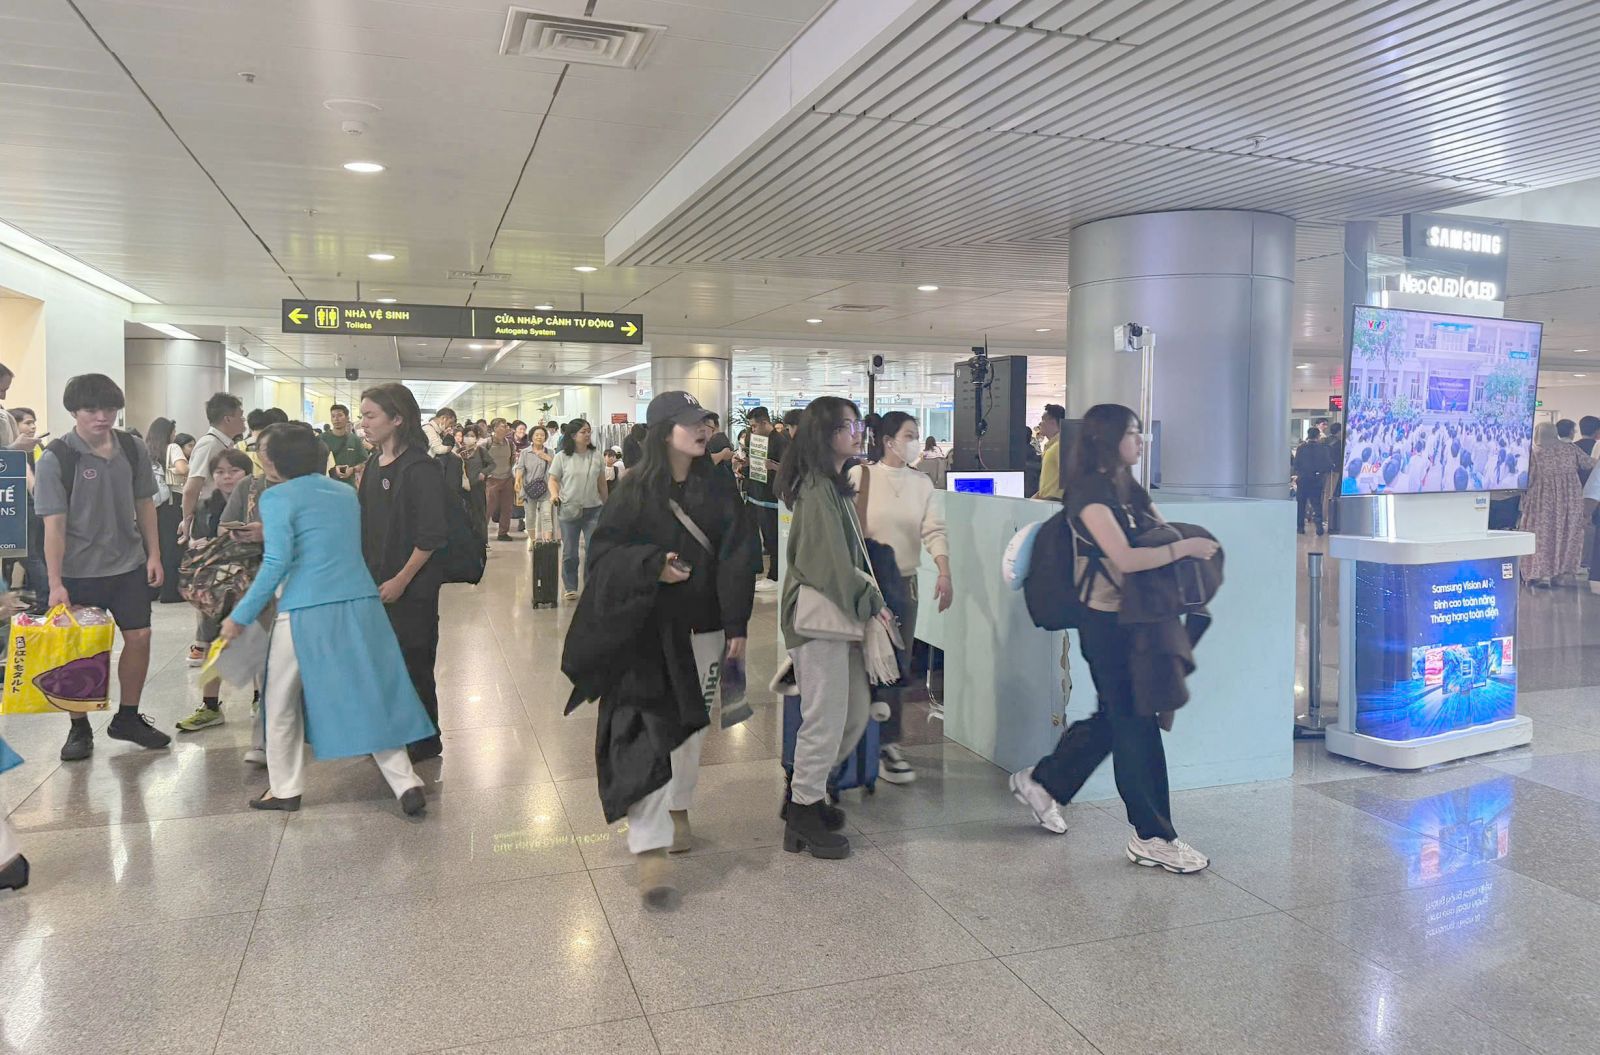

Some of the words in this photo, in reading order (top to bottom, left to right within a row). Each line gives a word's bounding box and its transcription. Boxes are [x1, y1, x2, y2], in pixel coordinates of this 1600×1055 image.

[1428, 226, 1501, 254] SAMSUNG
[1400, 273, 1426, 295] Neo
[345, 308, 367, 318] NHÀ
[369, 309, 383, 320] VỆ
[385, 311, 410, 320] SINH
[495, 313, 515, 324] CỬA
[517, 316, 543, 326] NHẬP
[545, 316, 571, 327] CẢNH
[574, 319, 586, 328] TỰ
[588, 318, 614, 329] ĐỘNG
[495, 327, 528, 335] Autogate
[530, 328, 556, 336] System
[1432, 584, 1462, 593] Samsung
[1463, 581, 1481, 590] Vision
[1482, 580, 1488, 588] AI
[1463, 596, 1478, 607] toàn
[1469, 609, 1484, 619] toàn
